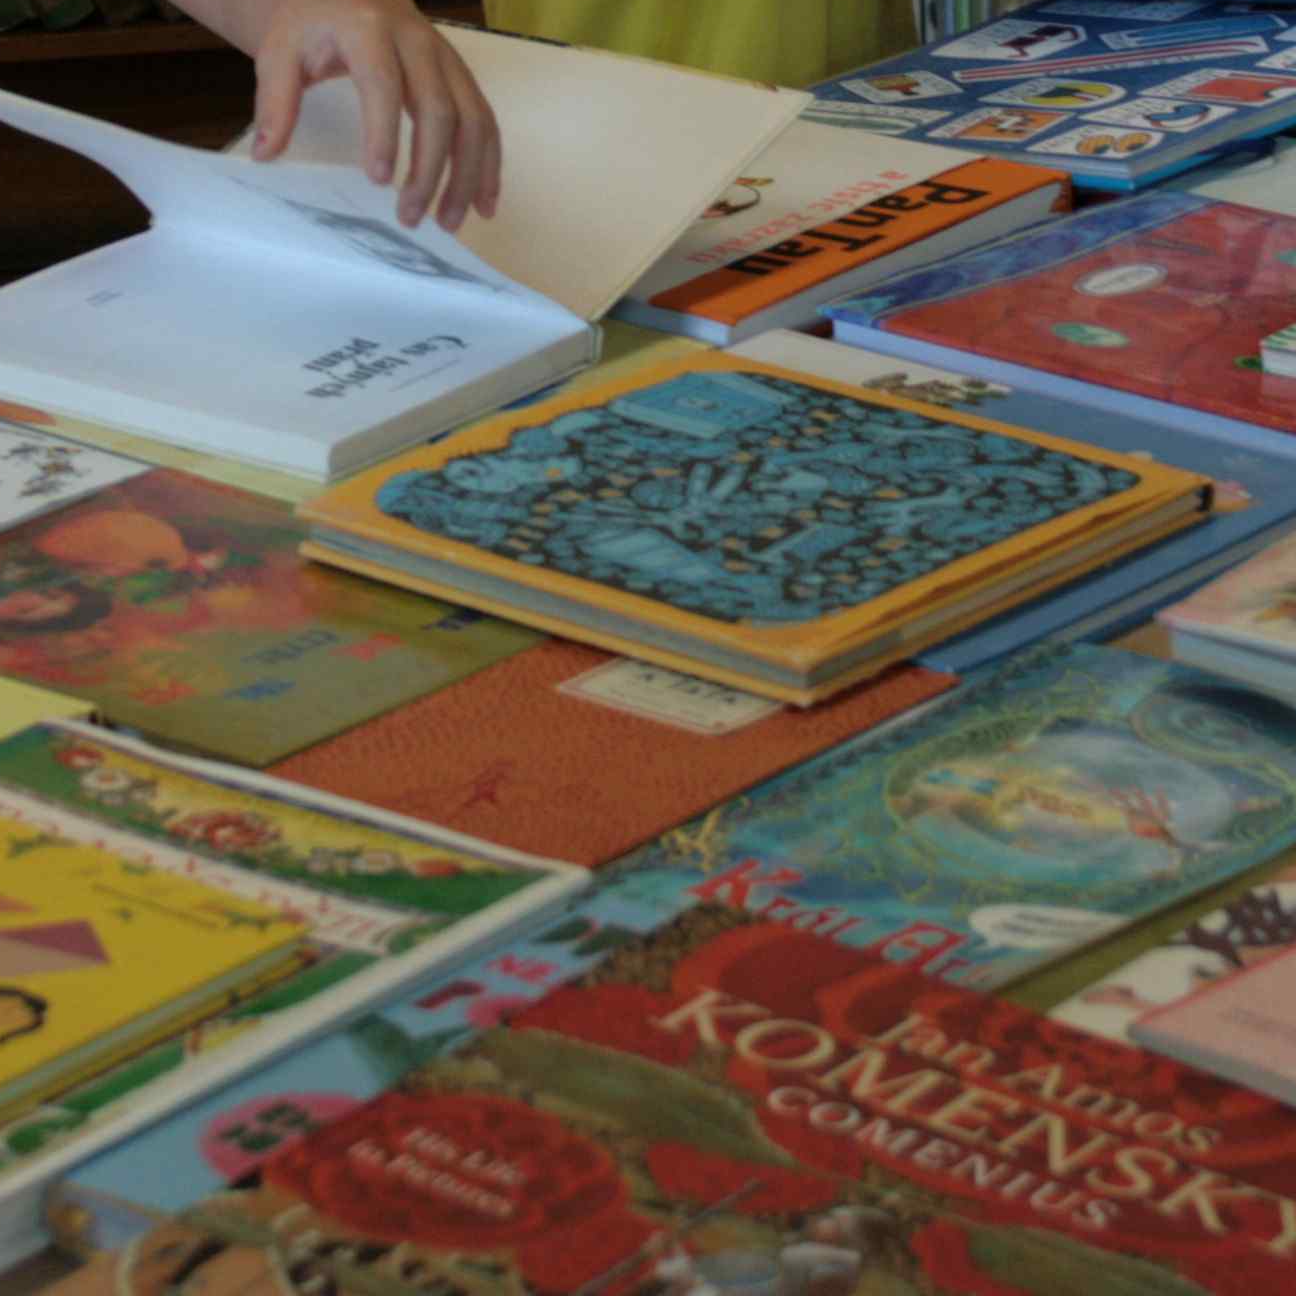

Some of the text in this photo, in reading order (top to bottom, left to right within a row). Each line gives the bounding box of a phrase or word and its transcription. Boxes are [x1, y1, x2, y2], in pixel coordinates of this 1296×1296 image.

[879, 1012, 1223, 1153] Jan Amos
[767, 1085, 1122, 1227] COMENIUS
